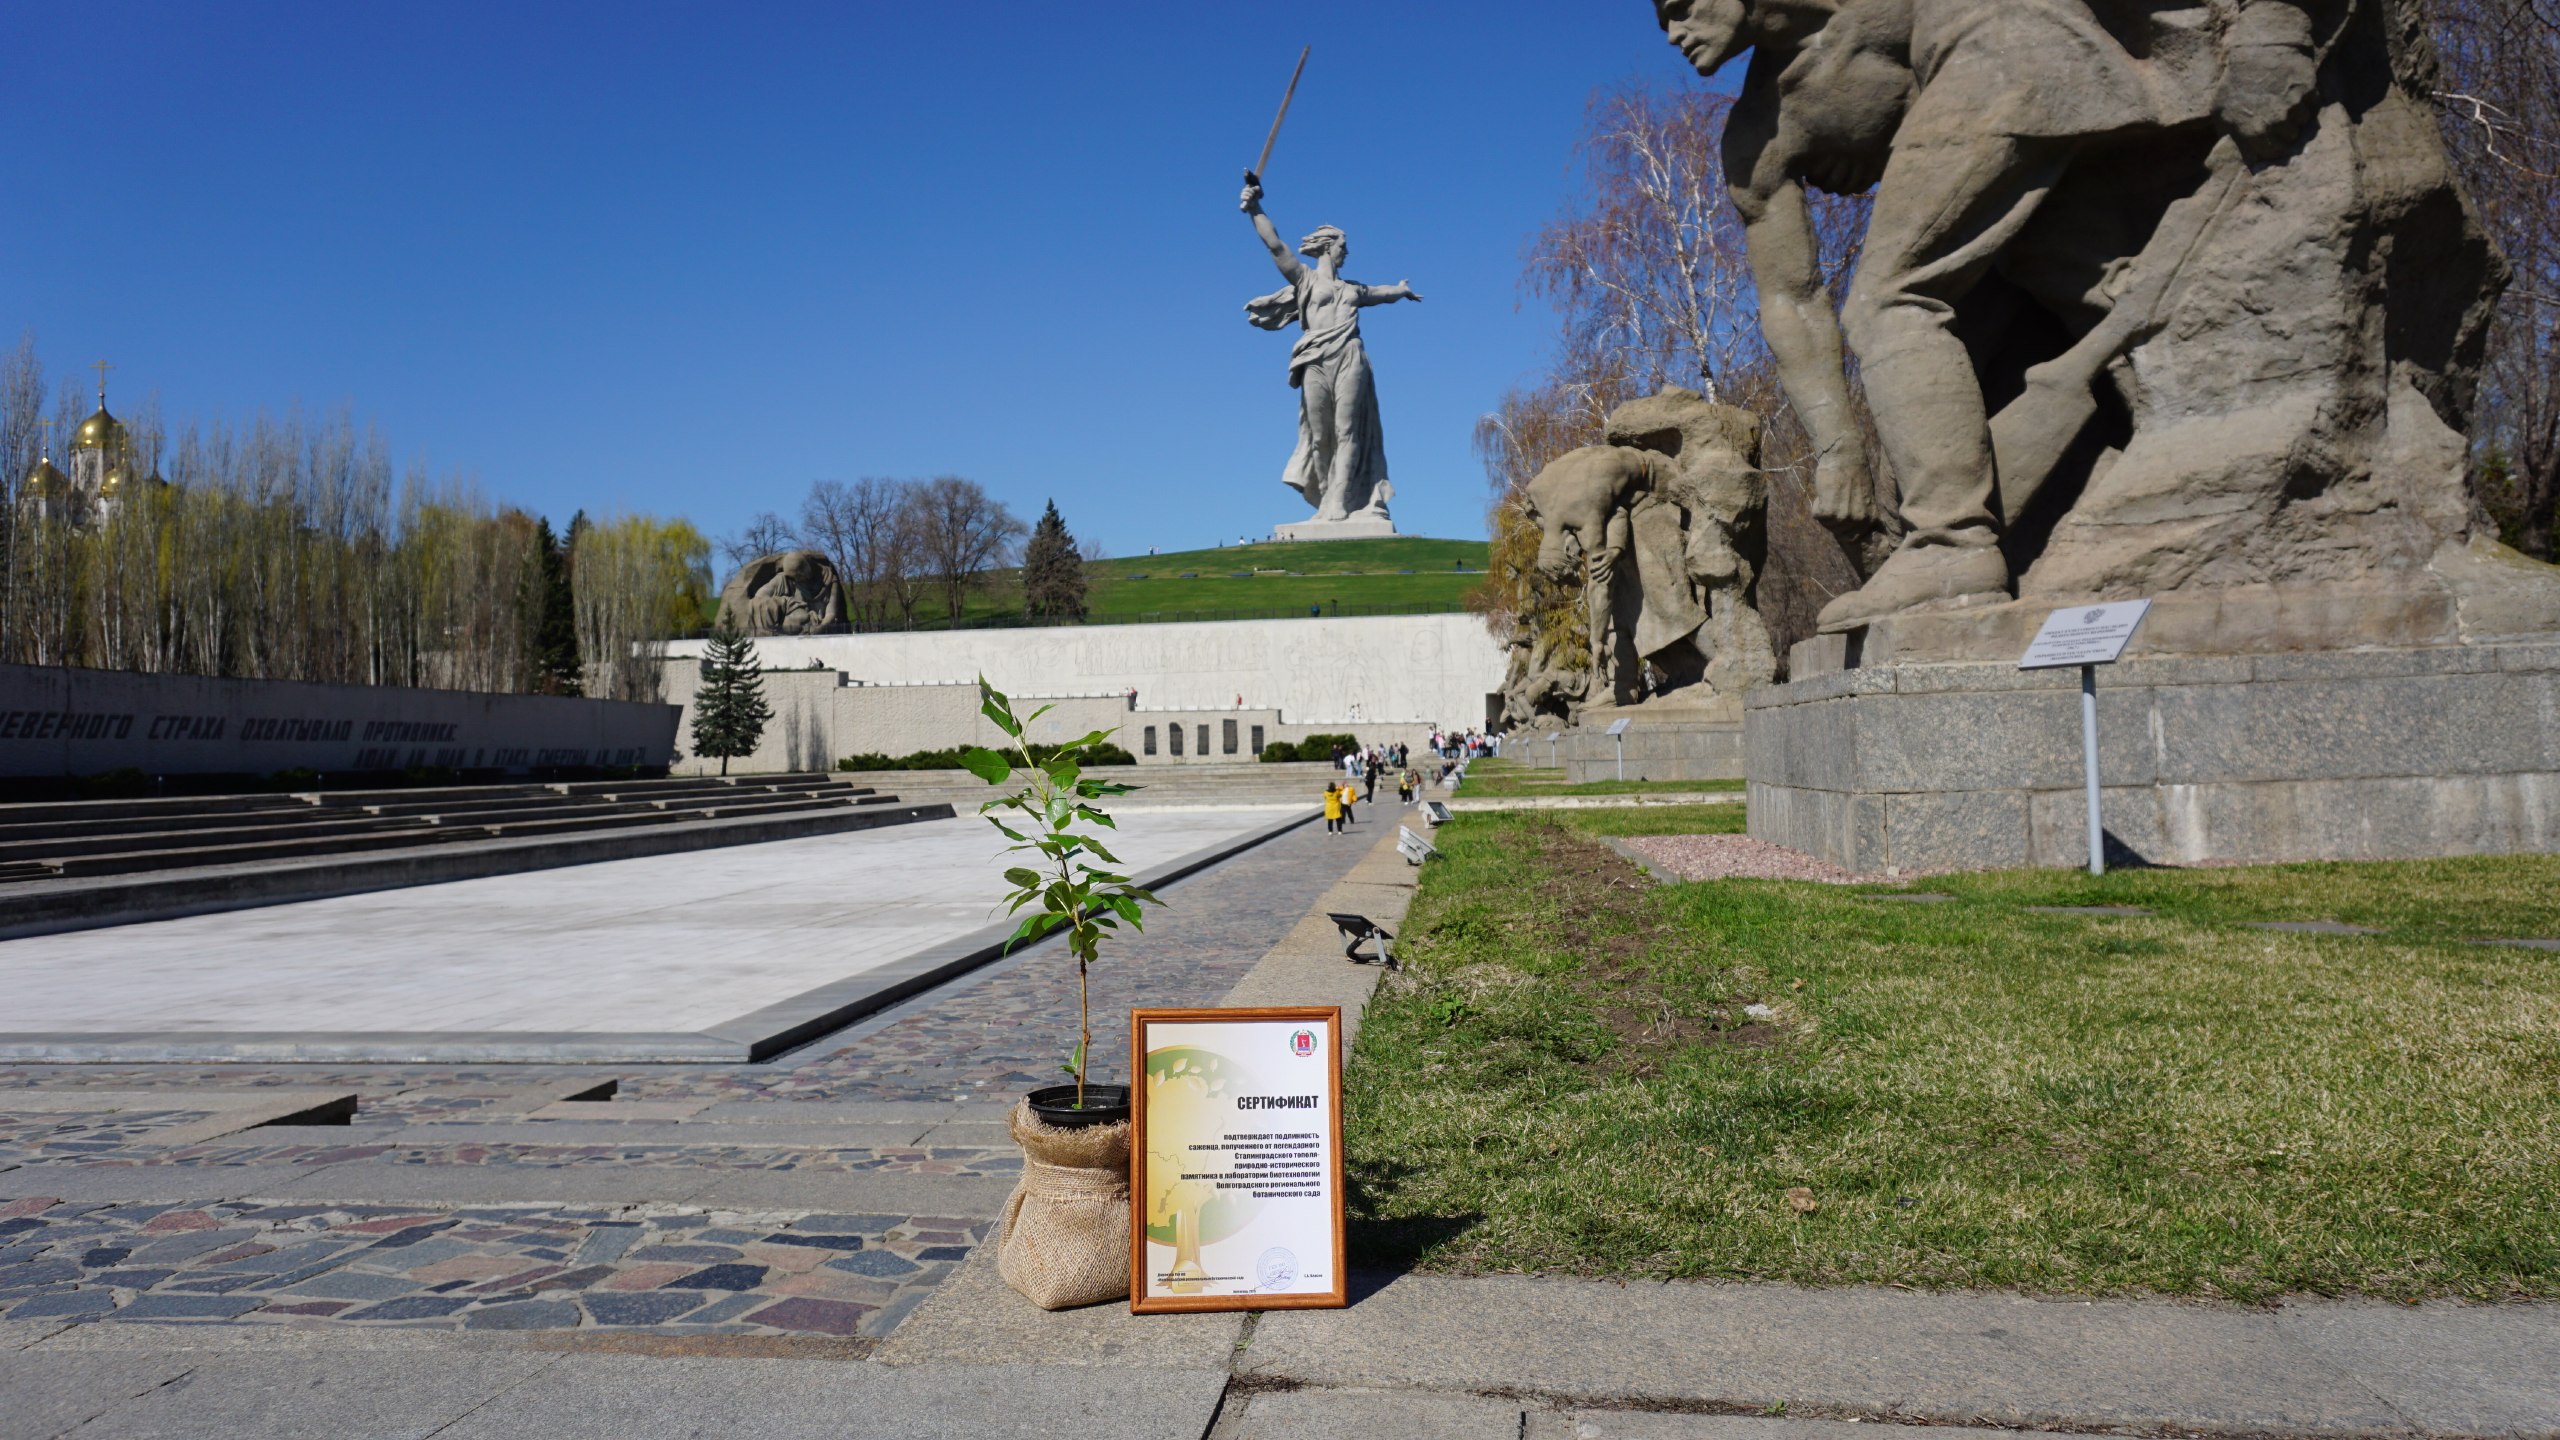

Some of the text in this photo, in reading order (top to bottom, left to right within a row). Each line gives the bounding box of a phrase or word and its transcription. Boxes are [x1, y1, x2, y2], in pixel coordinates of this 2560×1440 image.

[147, 716, 226, 740] СТРАХА
[239, 718, 353, 741] ОХВАТЫВАЛО
[1238, 1096, 1319, 1110] СЕРТИФИКАТ
